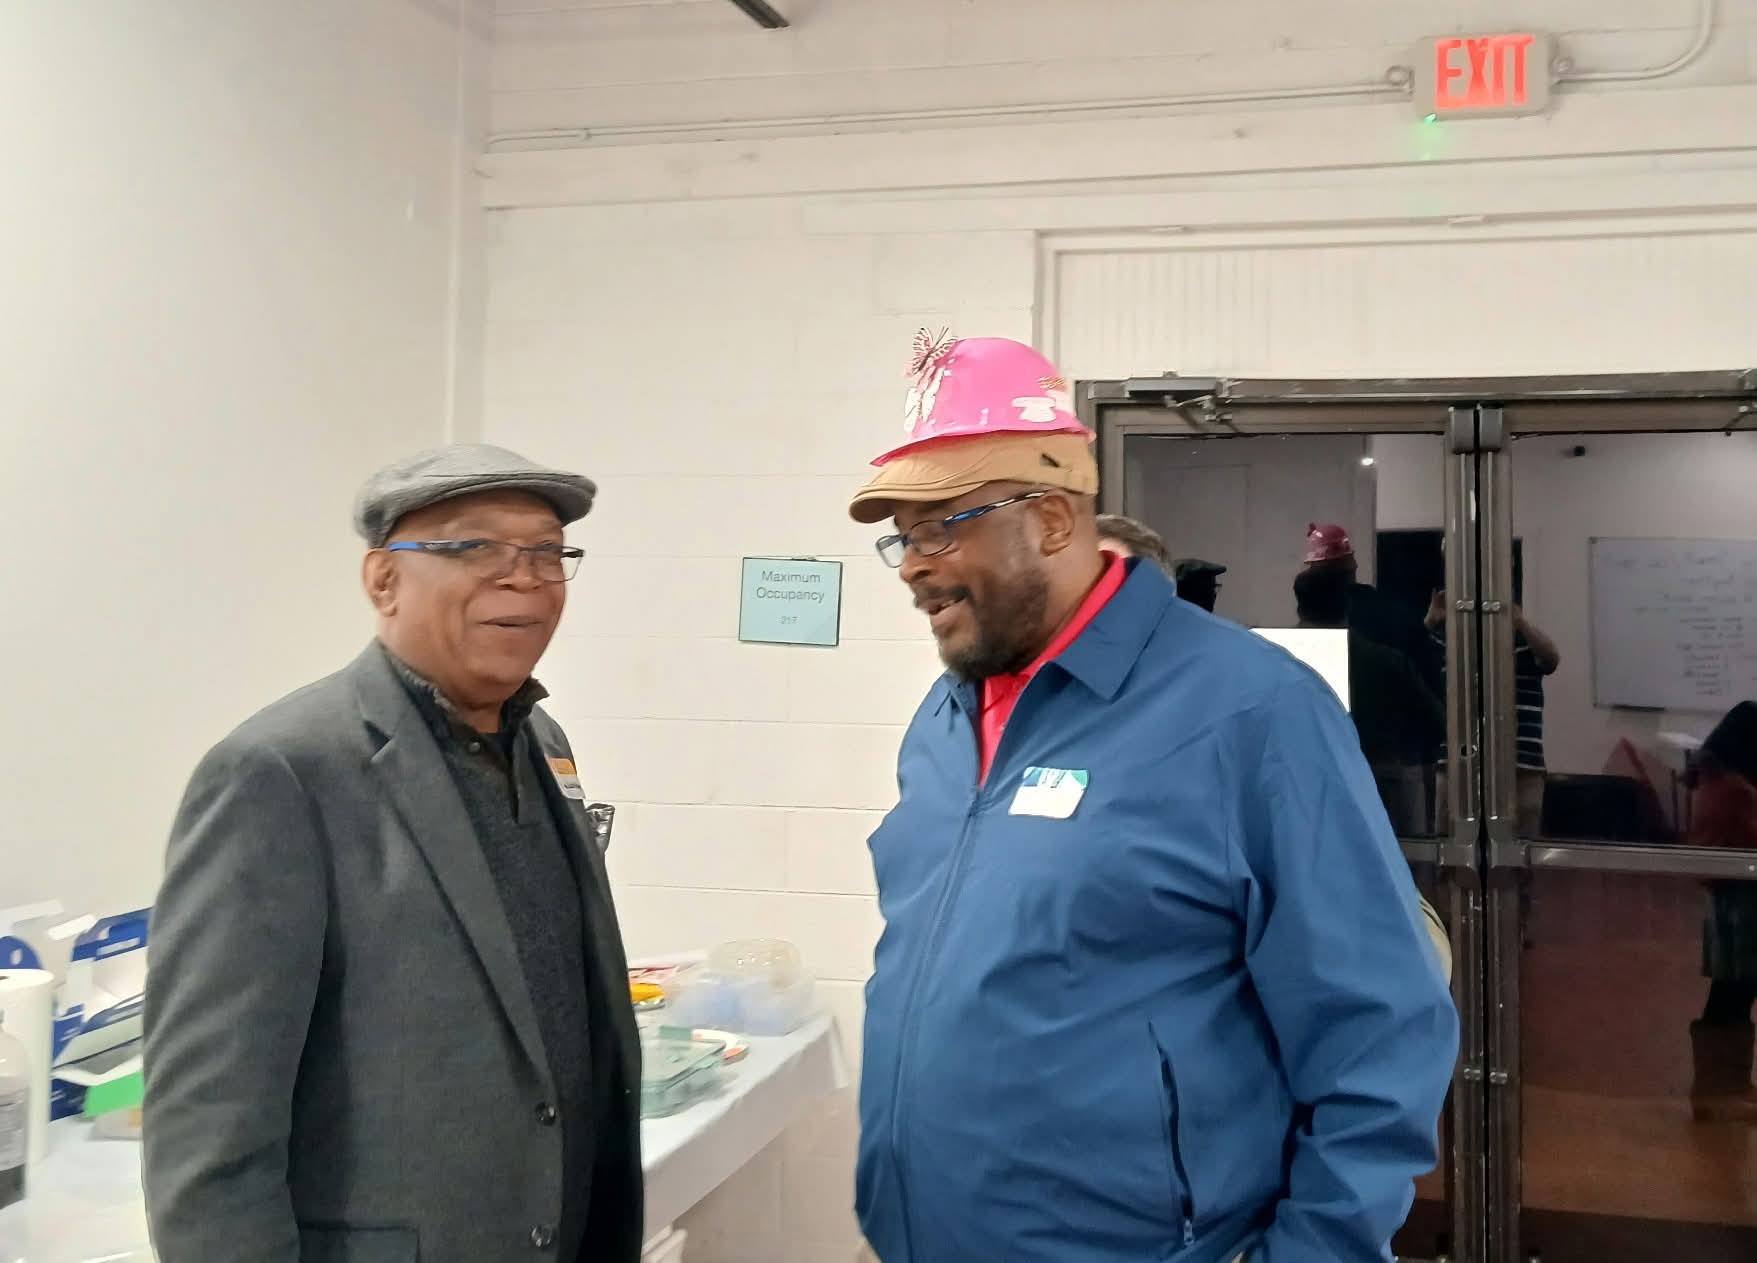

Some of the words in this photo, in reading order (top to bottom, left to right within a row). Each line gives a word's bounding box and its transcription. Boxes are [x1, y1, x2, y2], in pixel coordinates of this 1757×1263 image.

[1436, 34, 1534, 108] EXIT
[761, 570, 821, 583] Maximum
[756, 586, 825, 604] Occupancy
